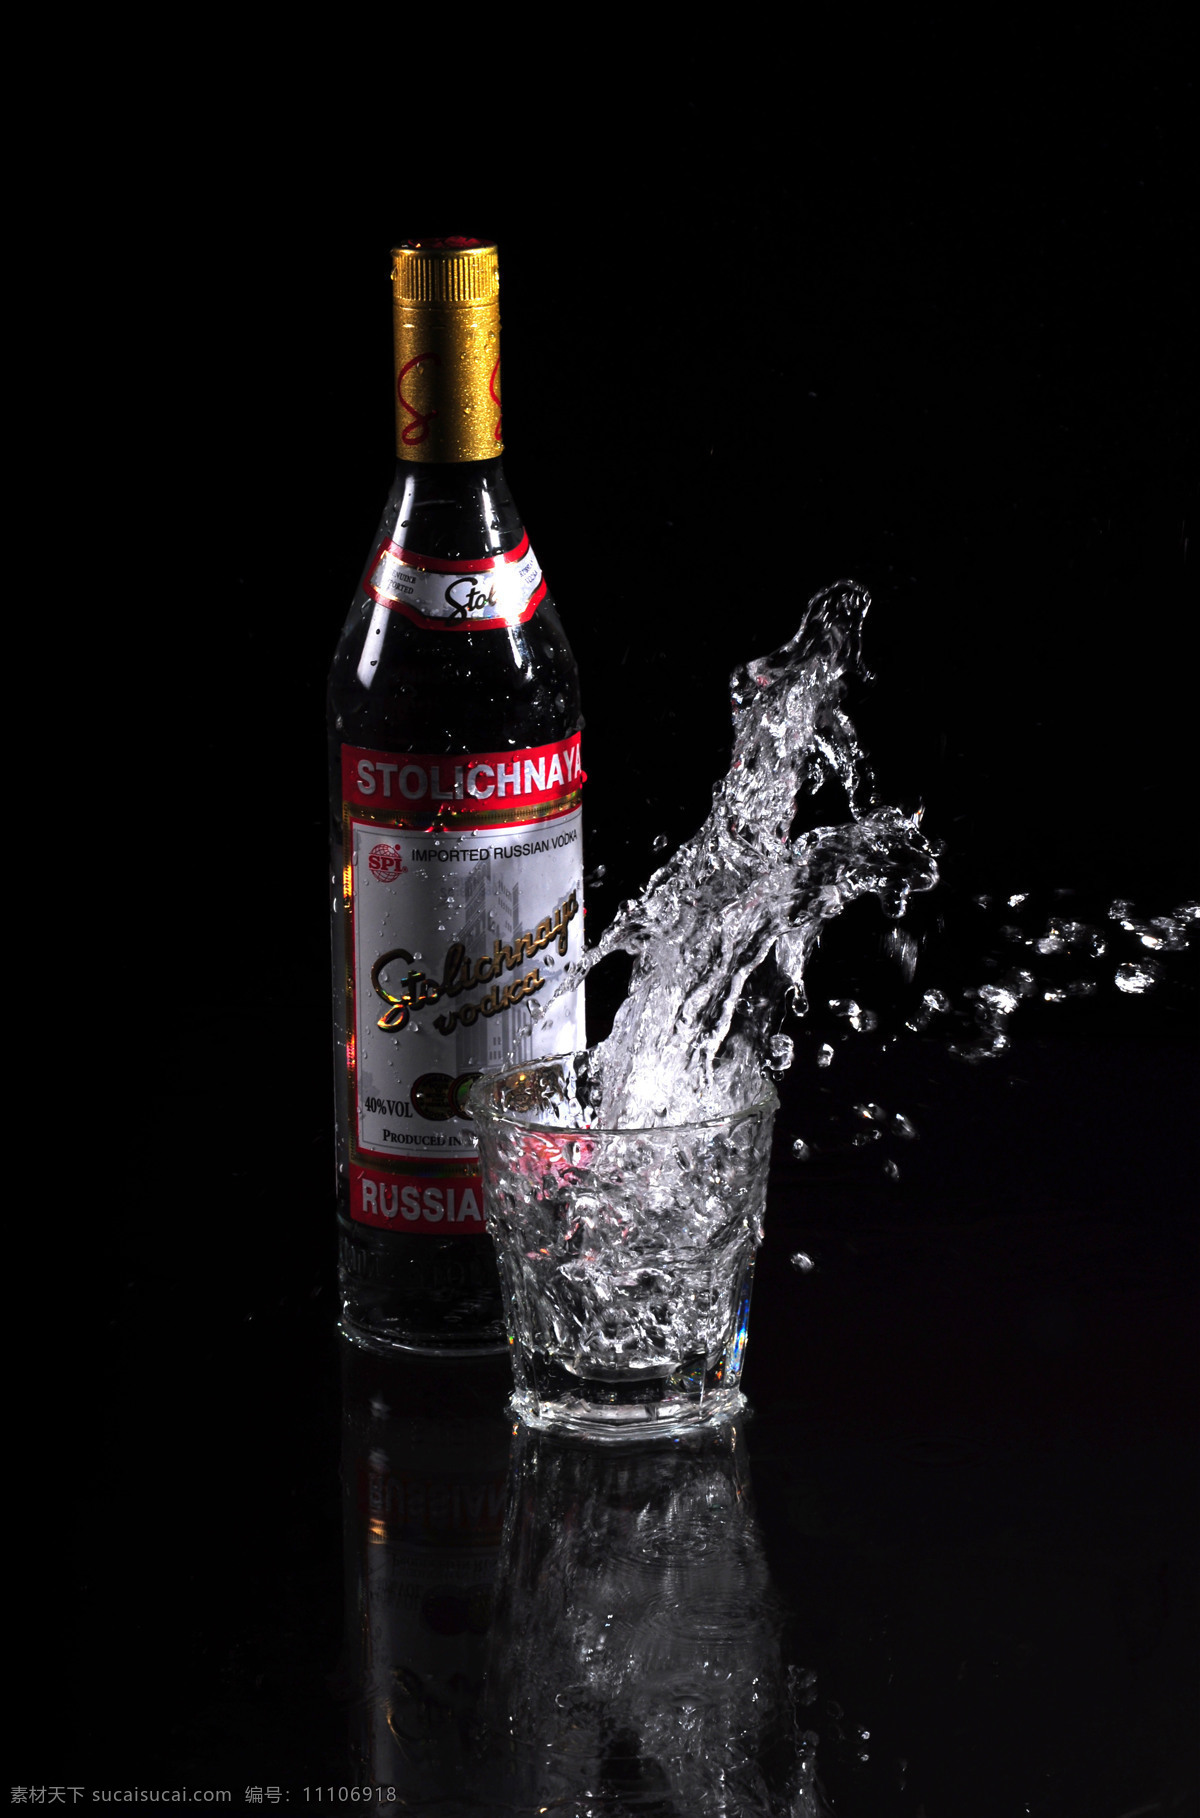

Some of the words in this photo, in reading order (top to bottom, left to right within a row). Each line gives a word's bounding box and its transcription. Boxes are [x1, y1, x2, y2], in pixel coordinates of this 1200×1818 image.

[357, 743, 581, 800] STOLICHNAYA
[412, 849, 490, 862] IMPORTED
[494, 839, 549, 859] RUSSIAN
[552, 829, 577, 850] VODKA
[371, 889, 579, 1033] Stolichnaya
[433, 968, 545, 1036] vodka
[364, 1097, 413, 1118] 40%VOL
[383, 1129, 446, 1146] PRODUCED
[448, 1137, 462, 1146] IN
[361, 1178, 487, 1222] RUSSIA
